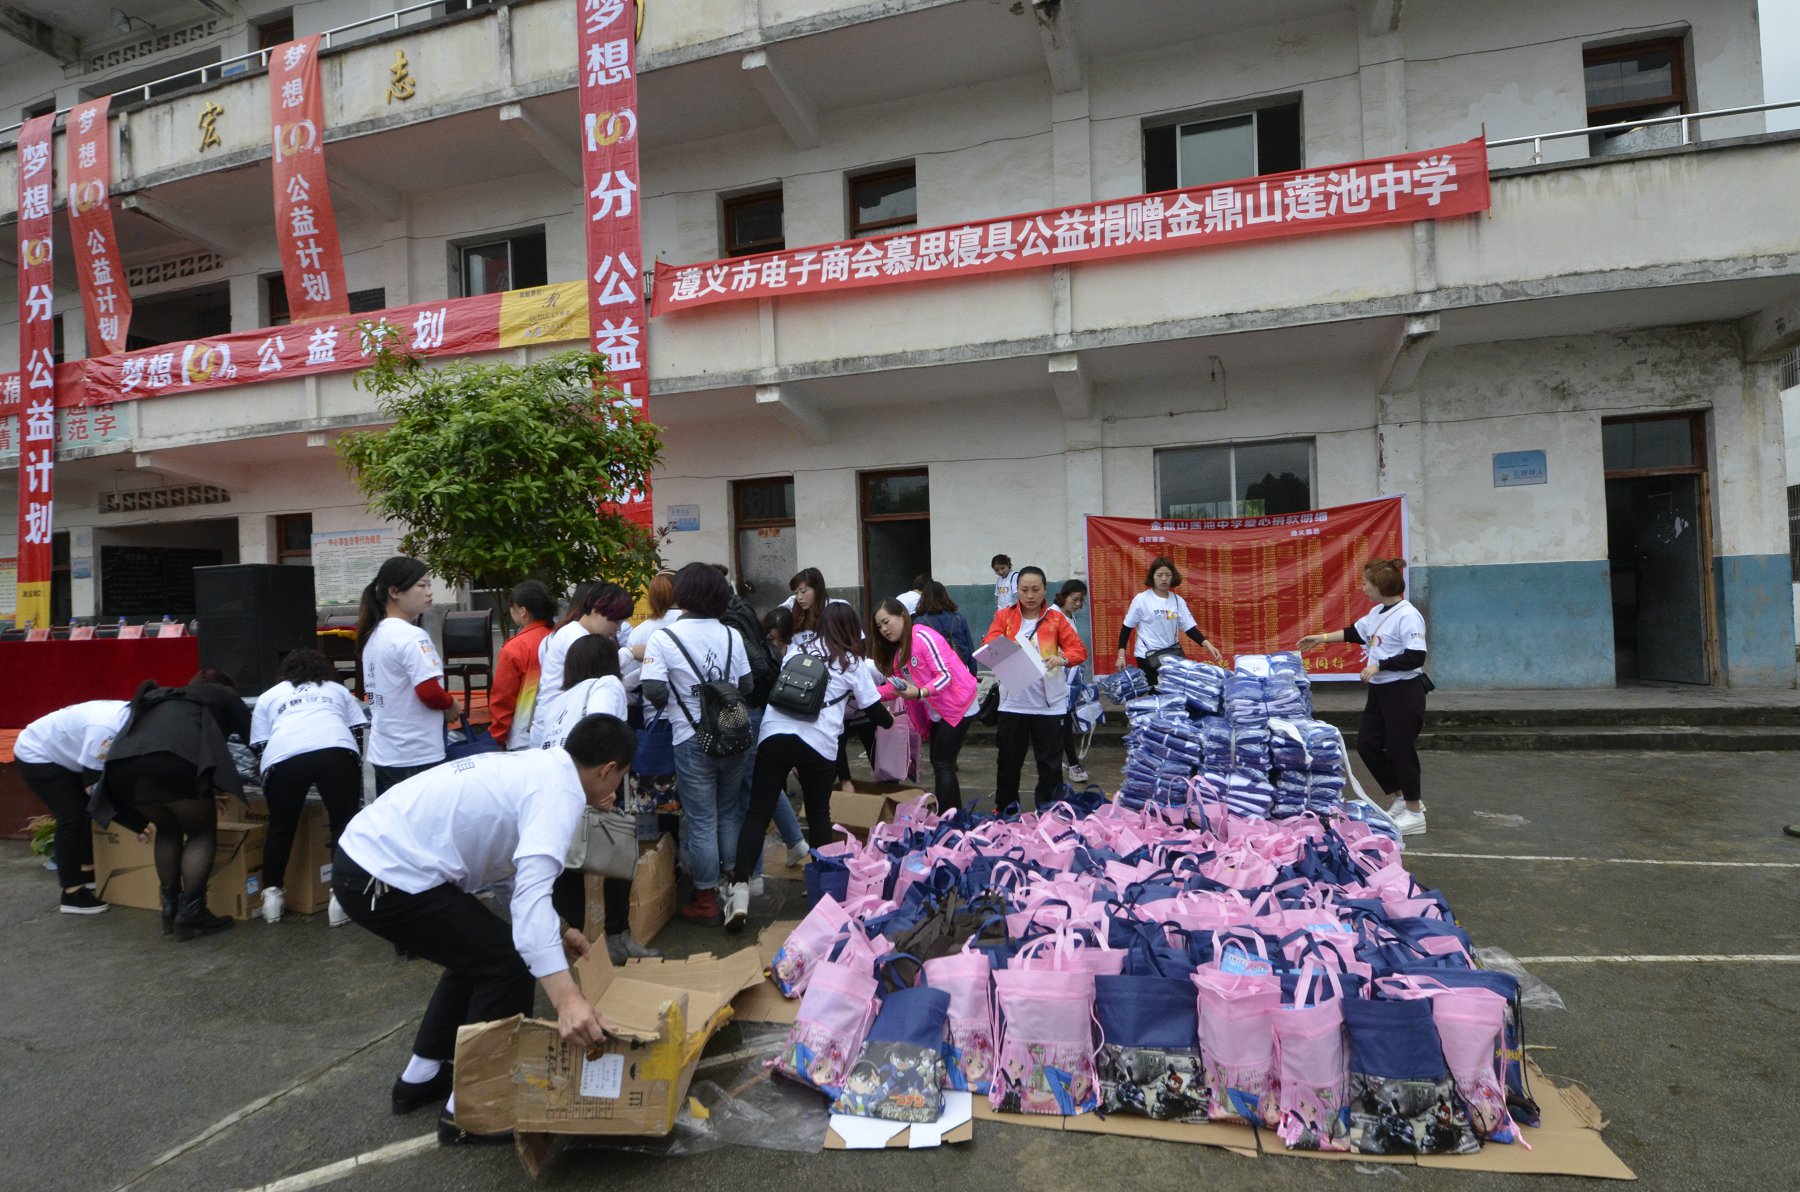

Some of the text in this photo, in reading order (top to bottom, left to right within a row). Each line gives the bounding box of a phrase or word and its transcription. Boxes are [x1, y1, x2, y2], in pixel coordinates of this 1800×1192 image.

[668, 154, 1458, 302] 遵义市电子商会慕思寝具公益捐赠金鼎山莲池中学
[1150, 511, 1329, 532] 金鼎山莲池中学爱心捐款明细
